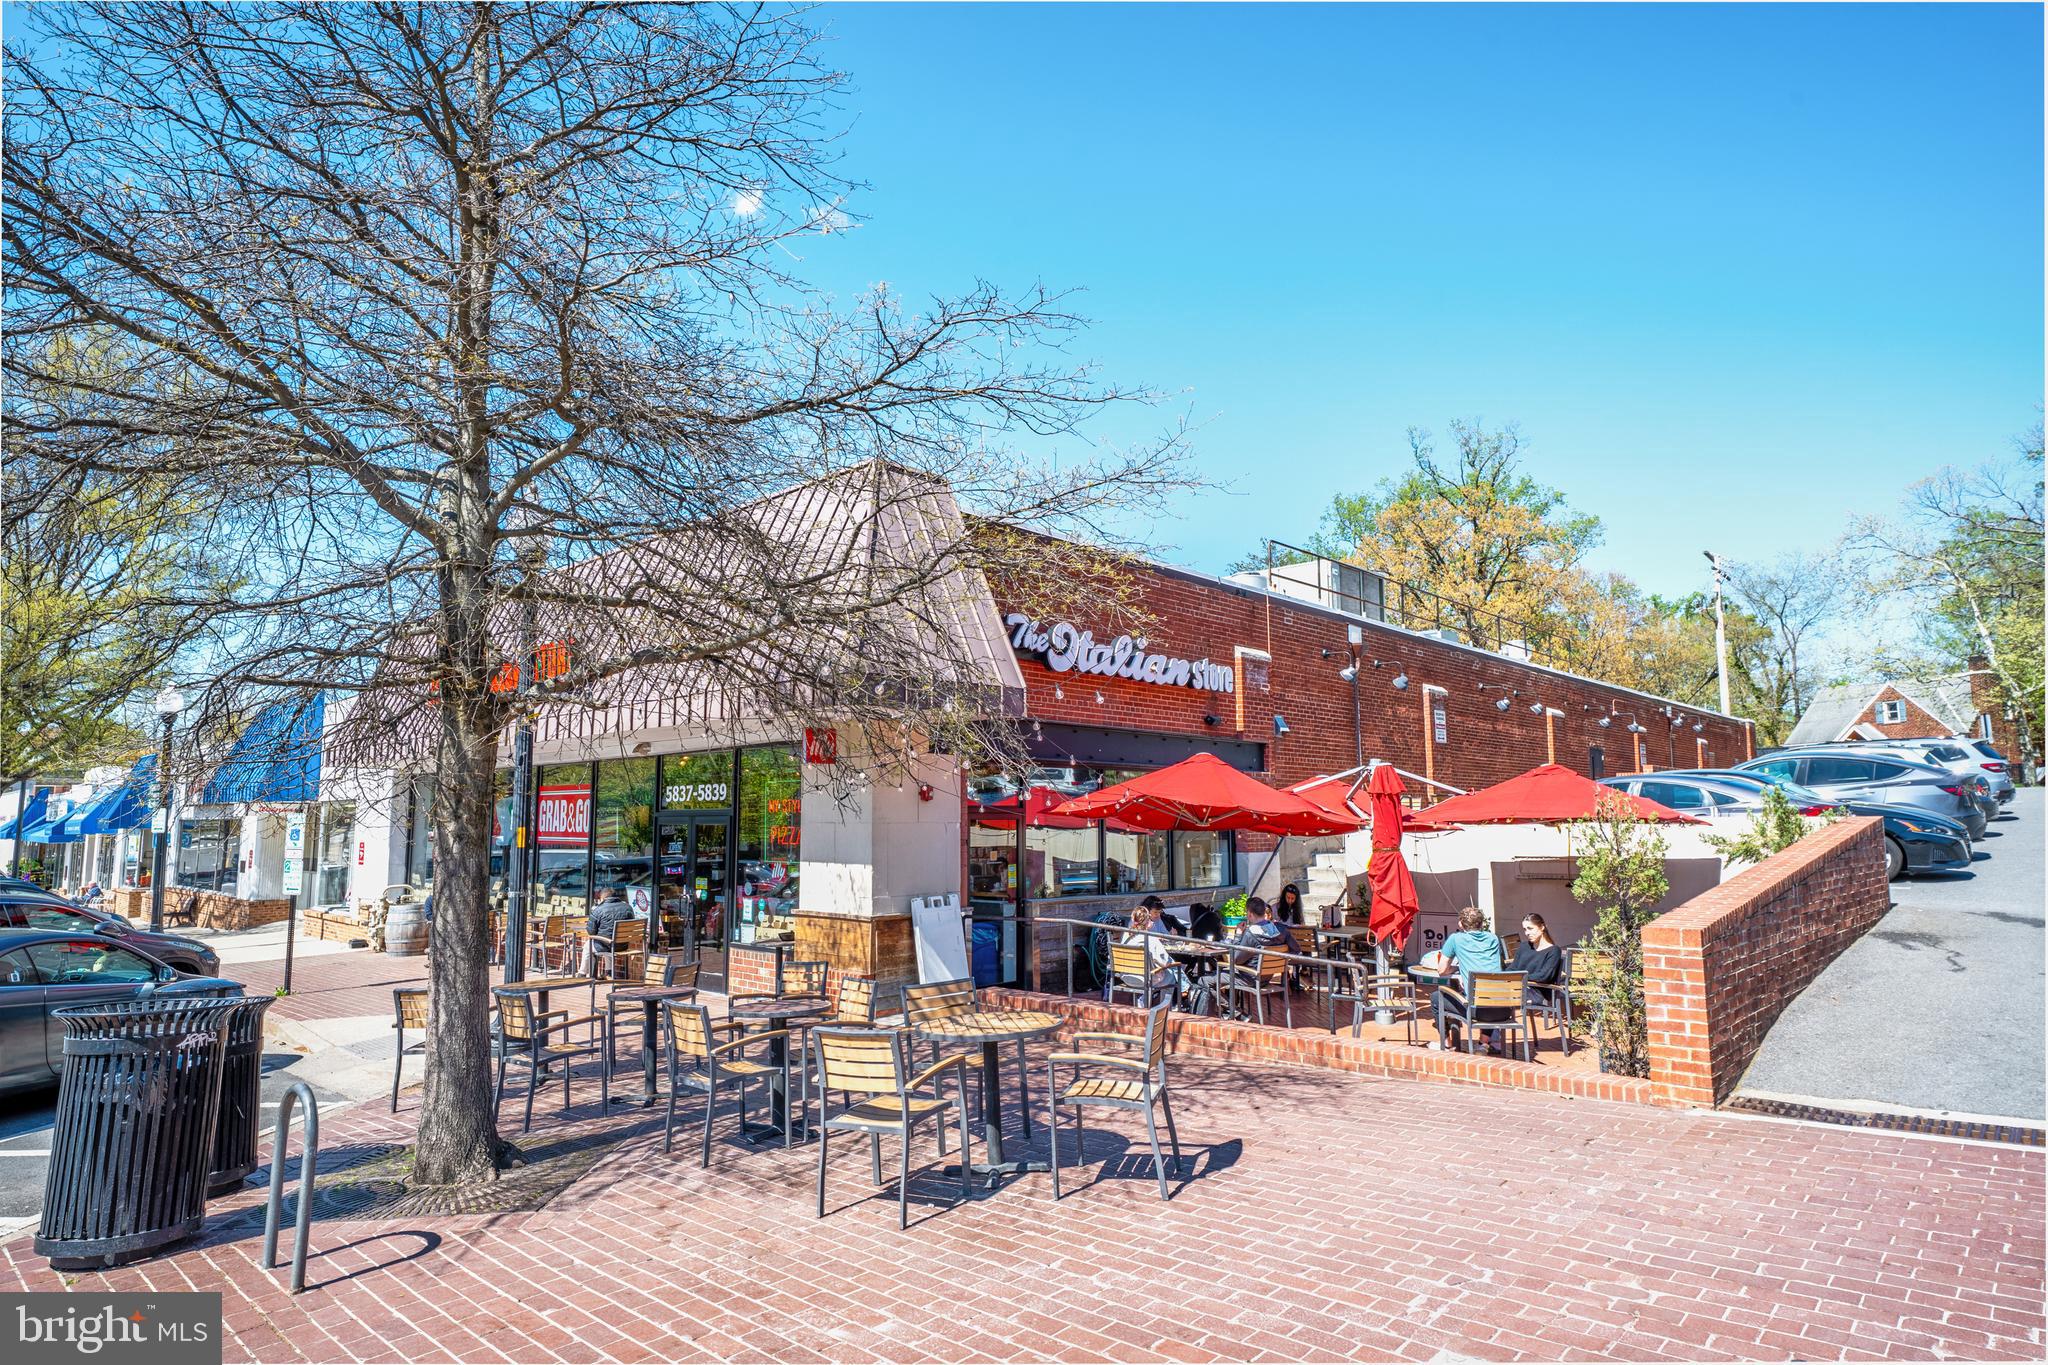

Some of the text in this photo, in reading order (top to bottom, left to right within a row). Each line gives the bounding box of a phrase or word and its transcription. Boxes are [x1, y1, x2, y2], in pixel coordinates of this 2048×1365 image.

[1006, 613, 1049, 652] The
[1047, 622, 1191, 686] Italian
[665, 783, 727, 802] 5837-5839
[768, 799, 780, 813] NY
